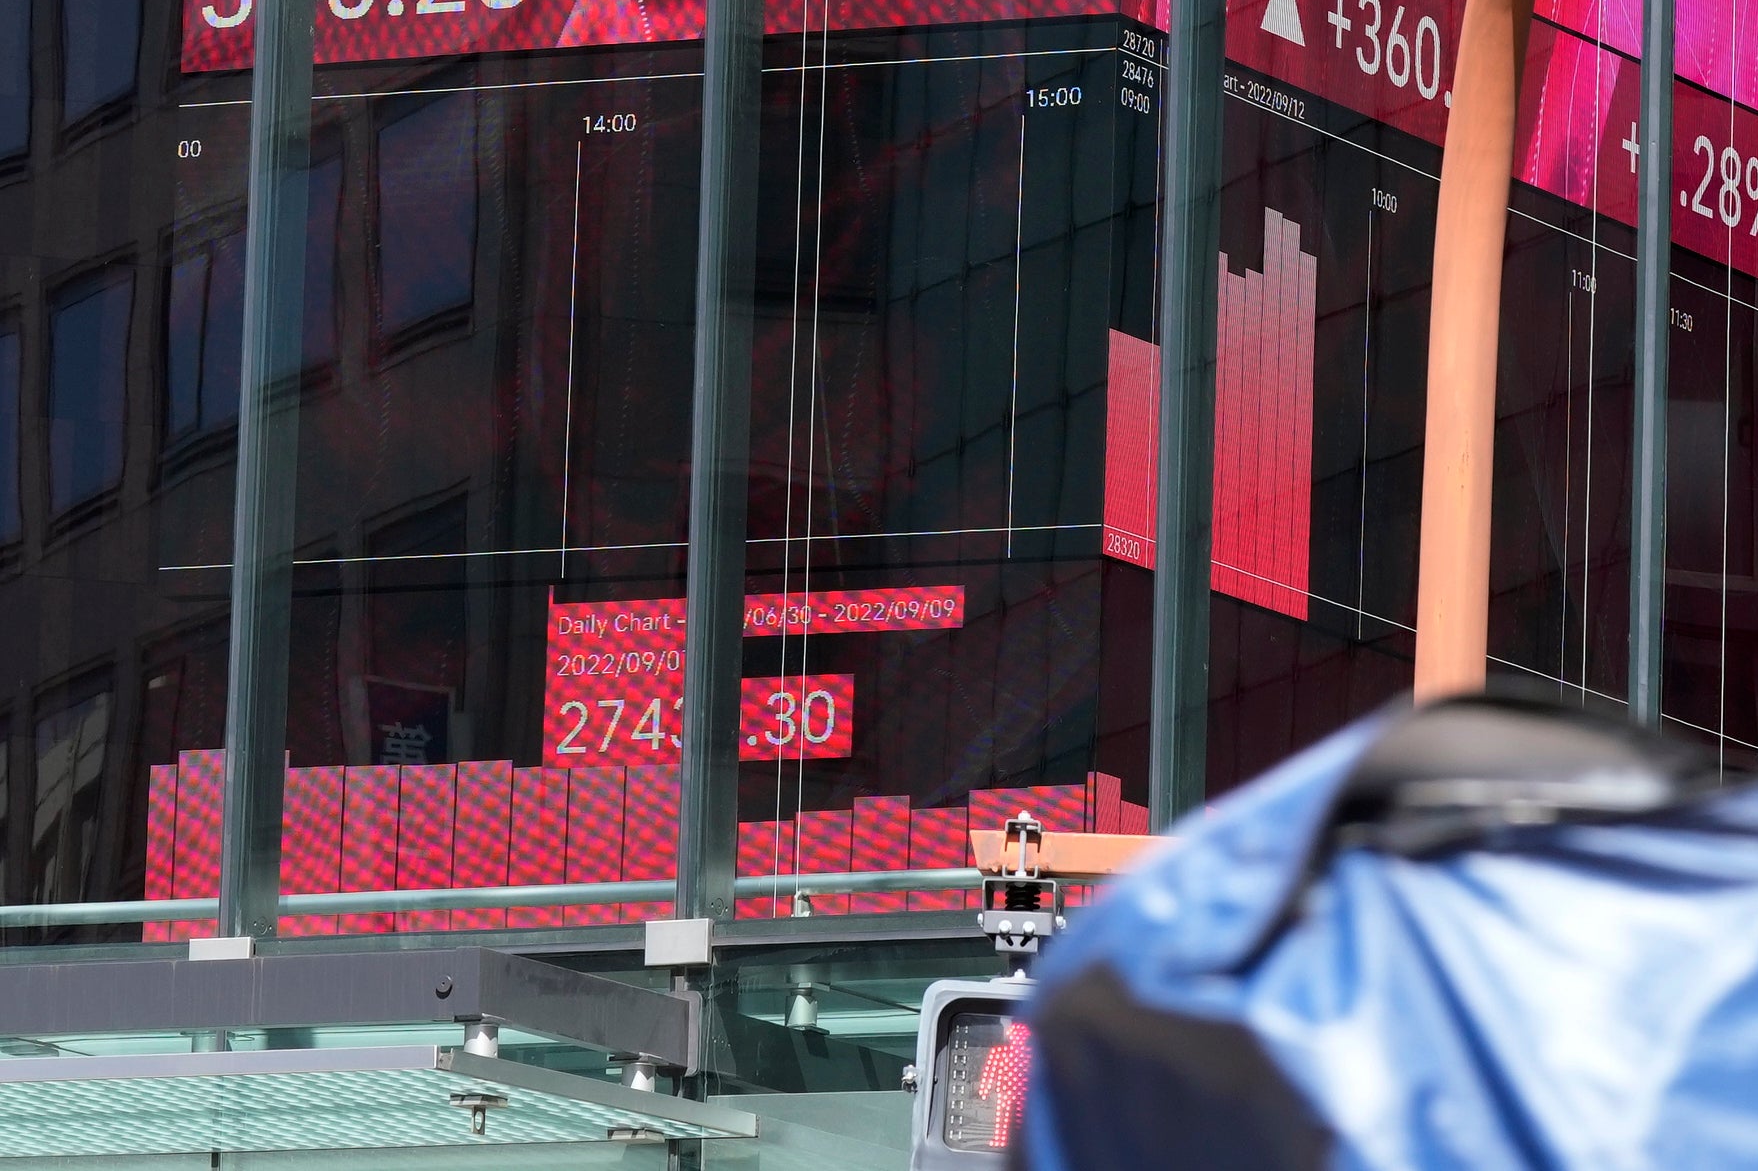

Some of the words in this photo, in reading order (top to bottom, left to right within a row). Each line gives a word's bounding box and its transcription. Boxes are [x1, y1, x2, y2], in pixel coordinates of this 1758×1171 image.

[1123, 30, 1155, 58] 28720
[1122, 60, 1154, 88] 28476
[1026, 87, 1082, 109] 15:00
[1121, 87, 1150, 114] 09:00
[1224, 74, 1238, 93] art
[1248, 80, 1305, 120] 2022/09/12
[582, 113, 637, 135] 14:00
[1371, 188, 1398, 214] 10:00
[1571, 268, 1597, 294] 11:00
[1670, 308, 1693, 332] 11:30
[1108, 533, 1140, 560] 28320
[558, 615, 608, 639] Daily
[614, 613, 672, 634] Chart
[743, 606, 812, 629] /06/30
[834, 599, 957, 625] 2022/09/09
[557, 650, 685, 677] 2022/09/0
[556, 689, 836, 755] 274.30
